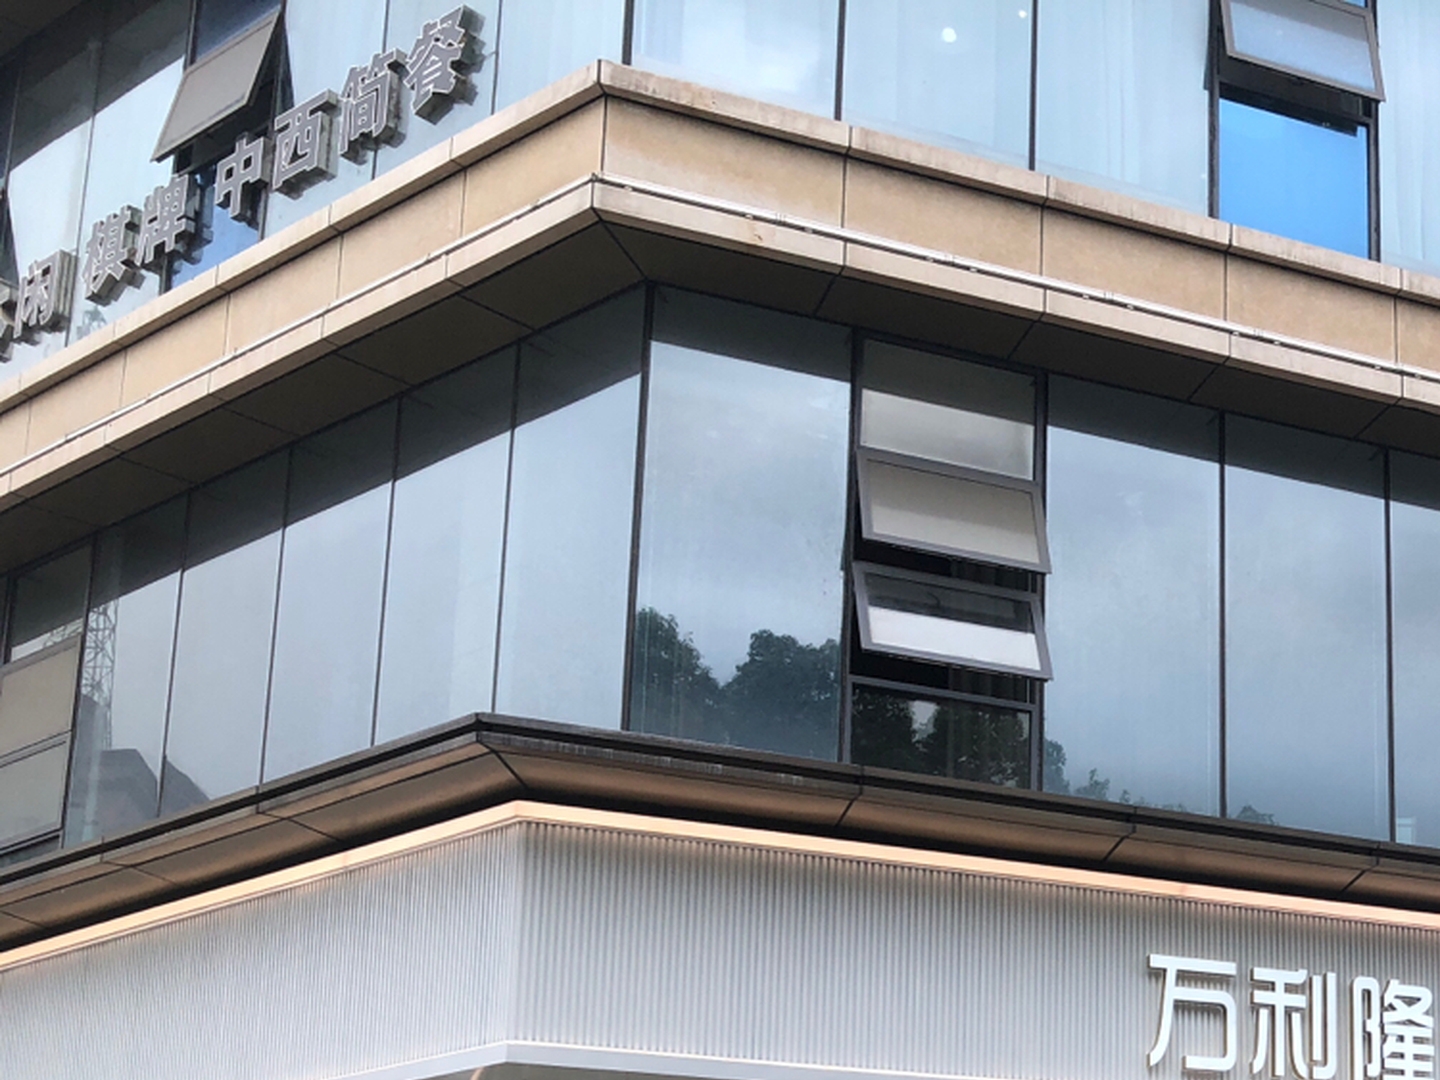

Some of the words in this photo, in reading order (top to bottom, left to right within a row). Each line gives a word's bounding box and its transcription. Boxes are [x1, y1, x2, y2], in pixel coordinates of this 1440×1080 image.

[82, 173, 198, 295] 棋牌
[214, 4, 472, 222] 中西简餐
